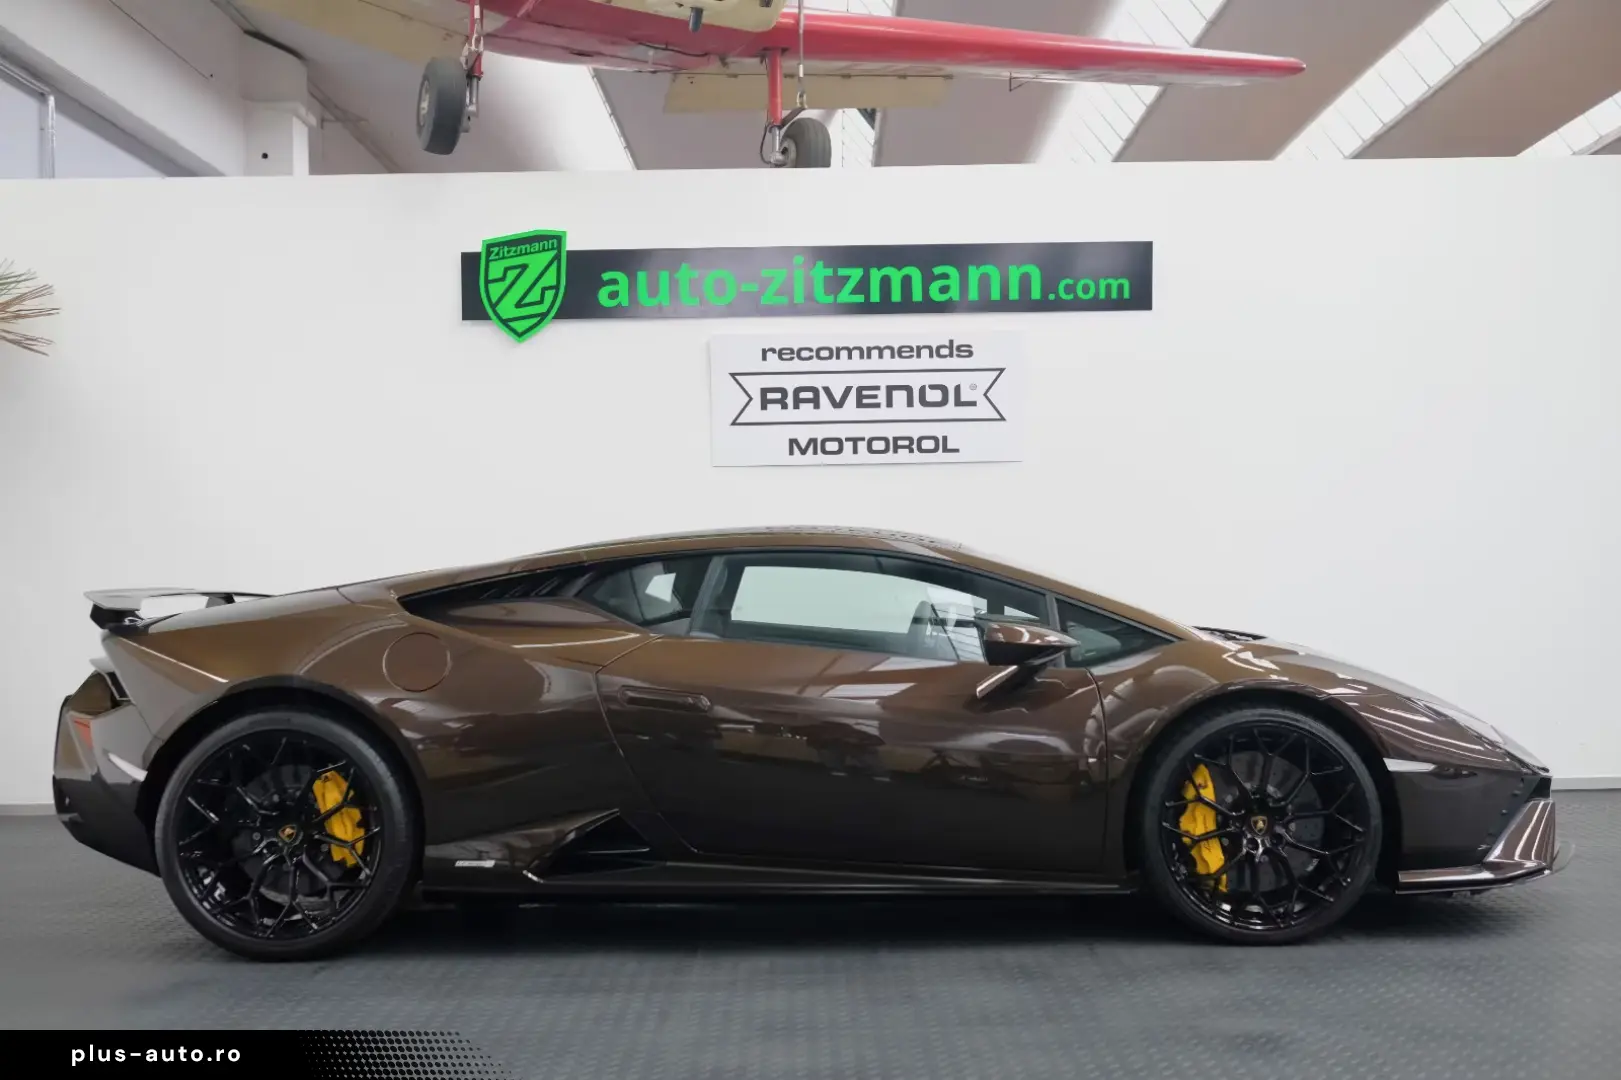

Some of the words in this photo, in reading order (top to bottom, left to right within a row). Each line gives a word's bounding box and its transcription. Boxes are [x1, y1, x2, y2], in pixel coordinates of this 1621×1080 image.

[489, 239, 558, 260] Zitzmann
[597, 255, 1131, 308] auto-zitzmann.com
[761, 339, 974, 362] recommends
[788, 435, 960, 456] MOTOROL
